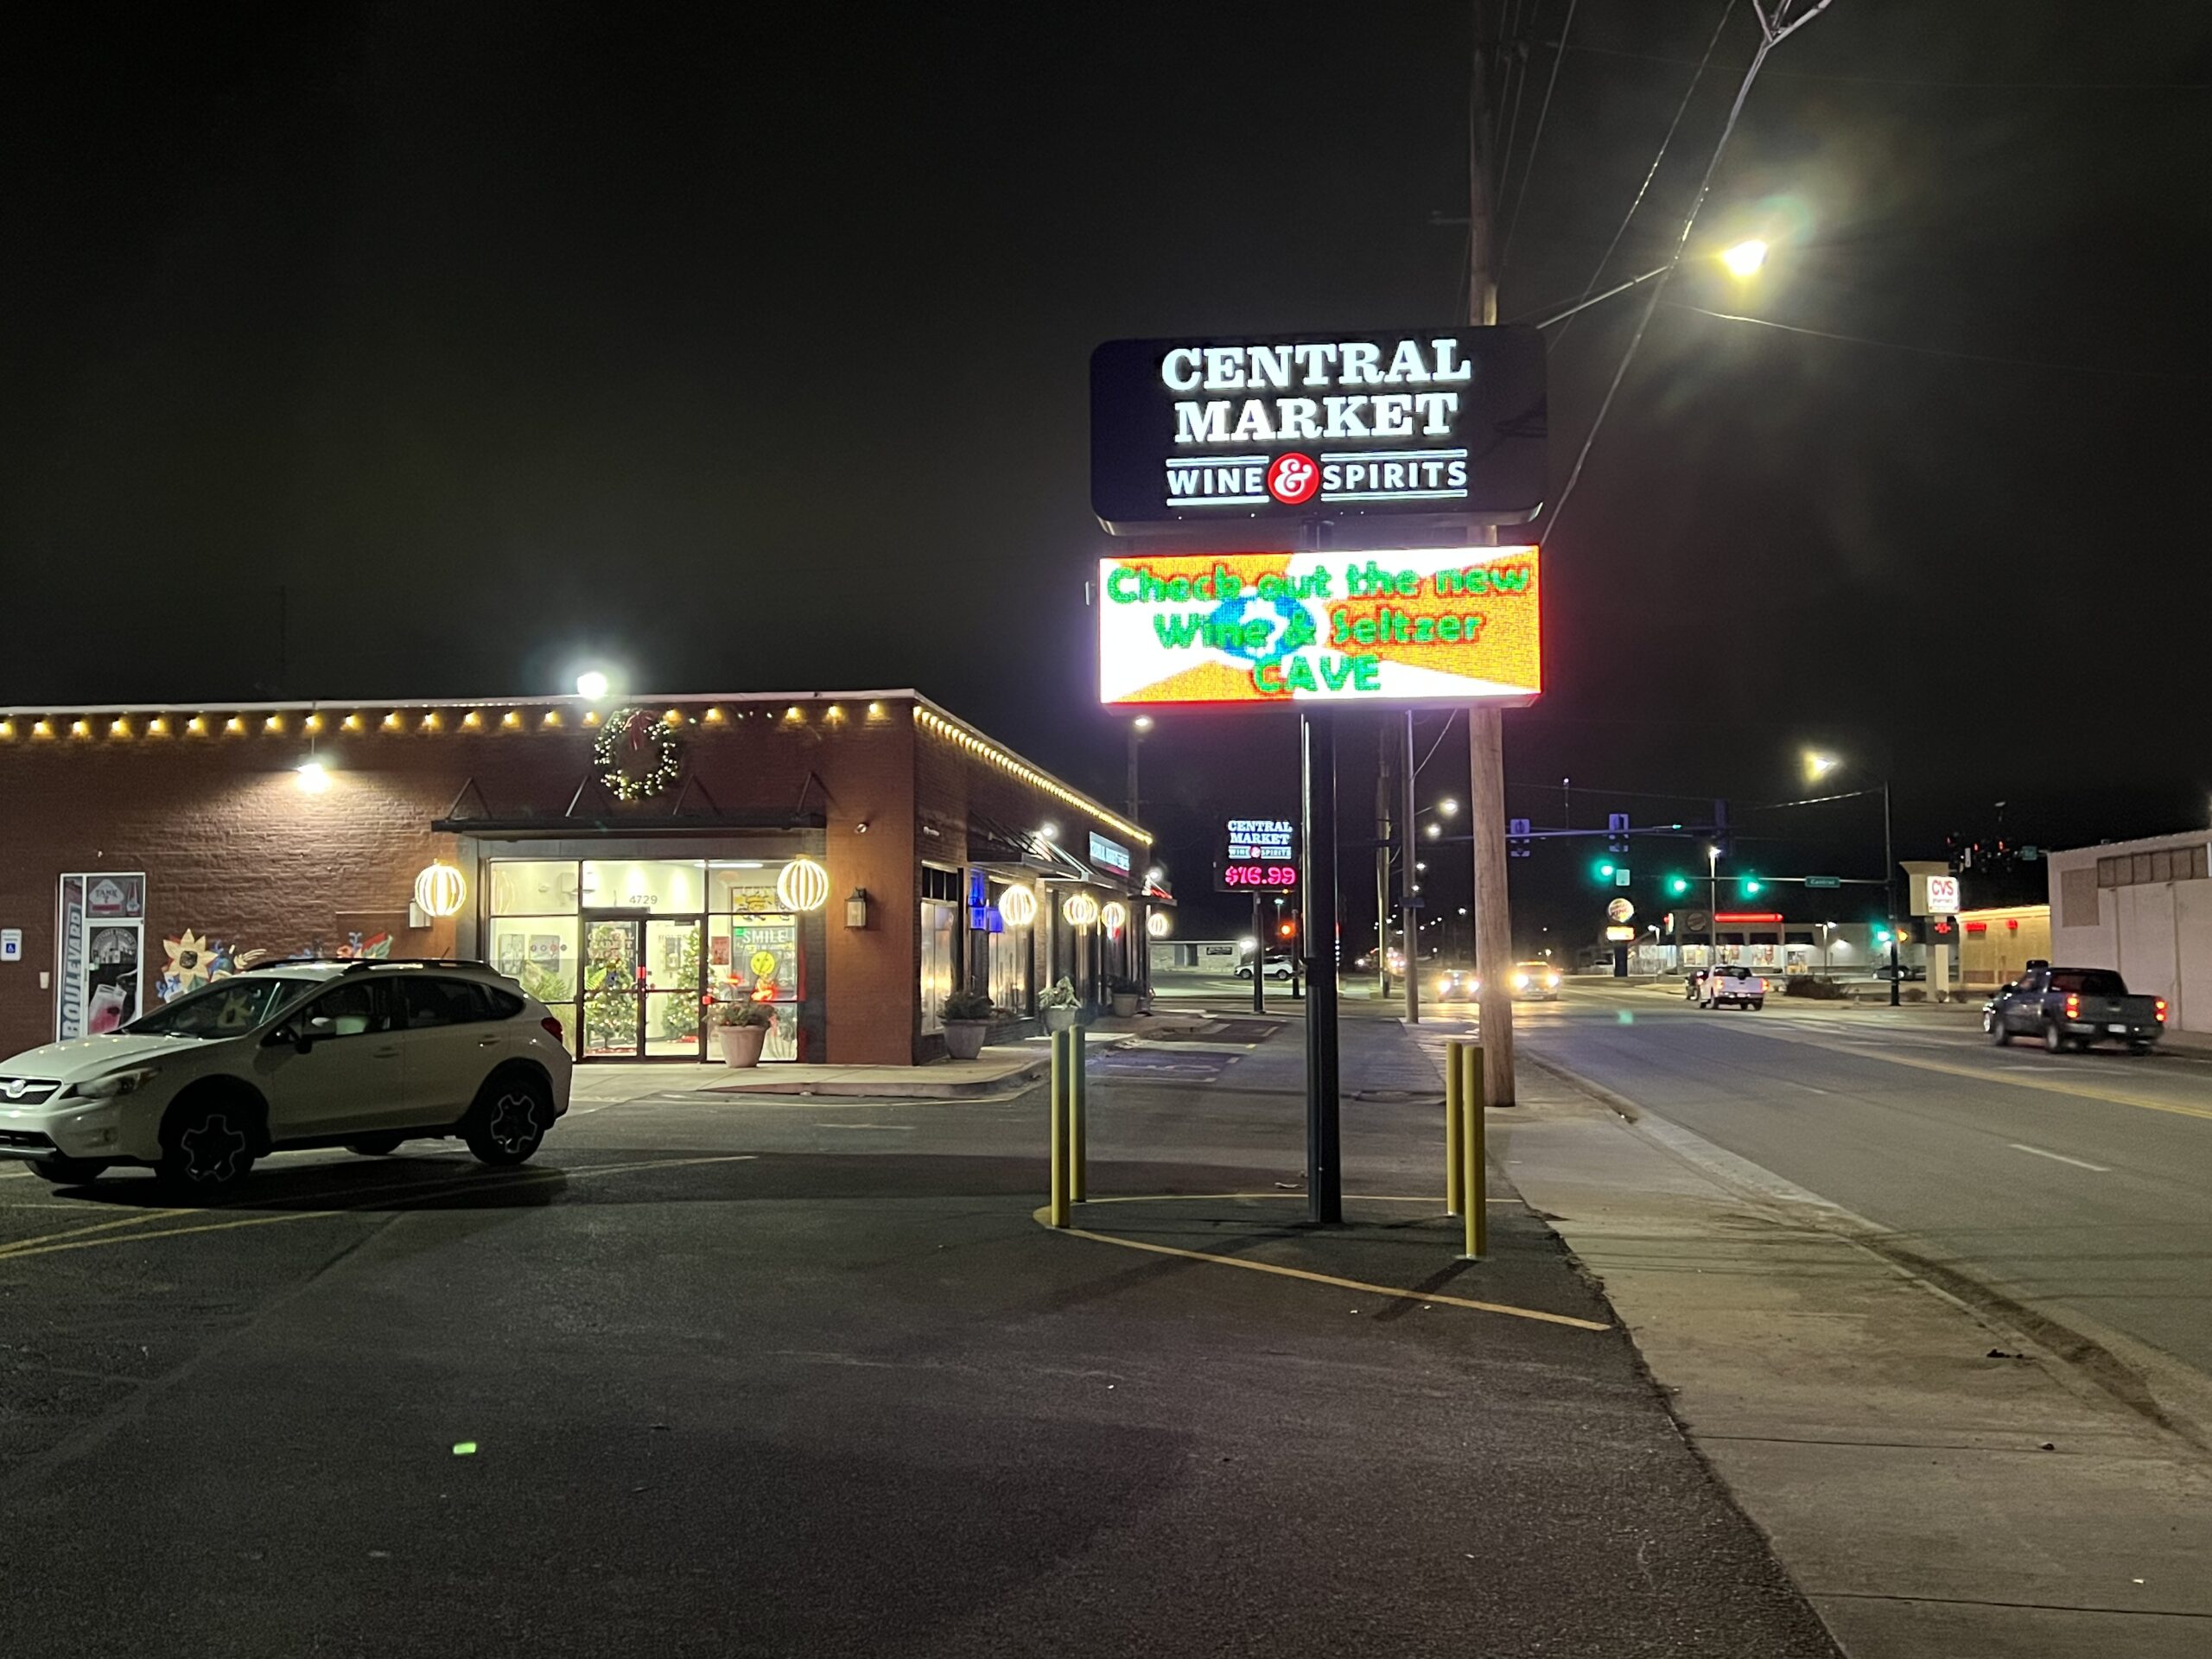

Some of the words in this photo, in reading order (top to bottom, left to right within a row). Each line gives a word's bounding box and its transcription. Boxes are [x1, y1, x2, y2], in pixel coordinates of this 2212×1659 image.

[1161, 338, 1471, 391] CENTRAL
[1174, 392, 1459, 443] MARKET
[1166, 467, 1263, 495] WINE
[1274, 458, 1313, 498] &
[1322, 461, 1468, 490] SPIRITS
[1107, 565, 1243, 603] Check
[1257, 565, 1333, 601] out
[1345, 560, 1421, 596] the
[1435, 567, 1530, 594] new
[1153, 613, 1270, 649] Wine
[1284, 611, 1317, 648] &
[1331, 607, 1484, 644] Seltzer
[1253, 654, 1382, 693] CAVE
[1228, 820, 1293, 832] CENTRAL
[1230, 832, 1290, 845] MARKET
[1225, 866, 1295, 886] $16.99
[1932, 880, 1954, 895] CVS
[95, 889, 118, 898] TANK
[629, 895, 658, 905] 4729
[743, 929, 785, 944] SMILE
[62, 910, 83, 1037] BOULEVARD
